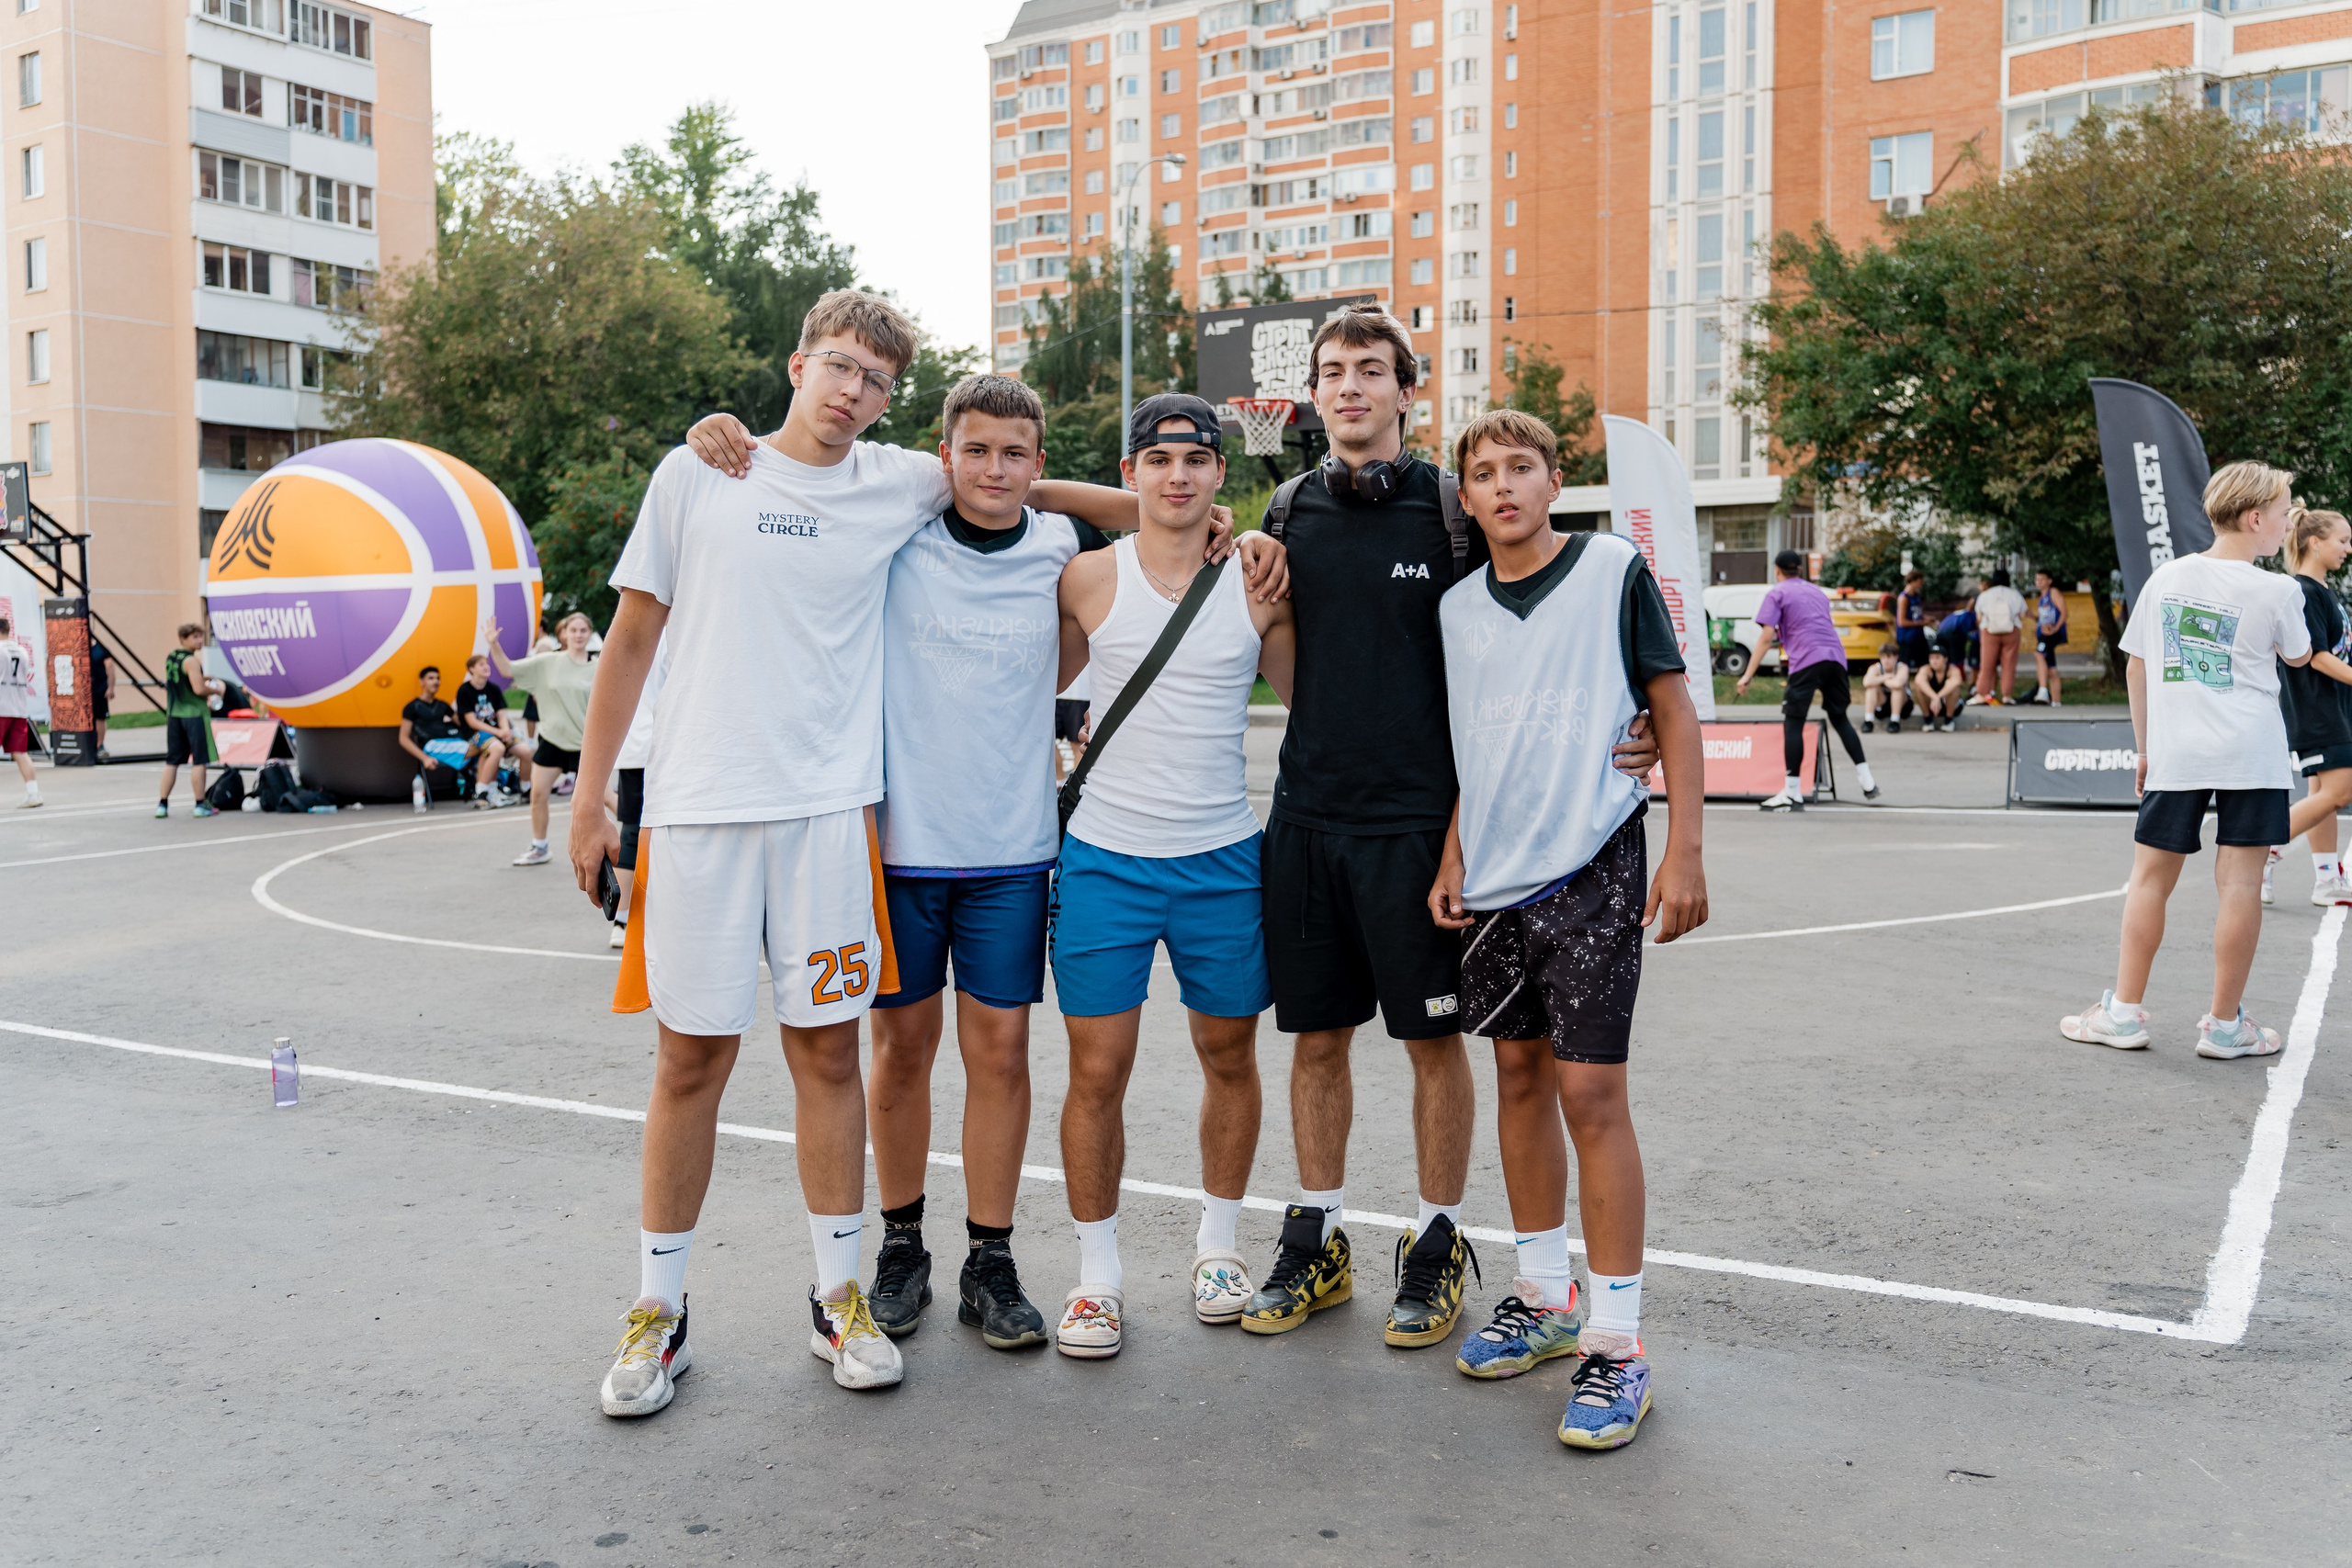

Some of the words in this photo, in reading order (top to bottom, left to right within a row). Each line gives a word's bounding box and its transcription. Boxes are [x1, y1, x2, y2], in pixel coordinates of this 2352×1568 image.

[2132, 441, 2176, 573] BASKET
[758, 512, 820, 525] MYSTERY
[758, 523, 820, 538] CIRCLE
[1390, 562, 1430, 580] A+A
[808, 940, 869, 1006] 25
